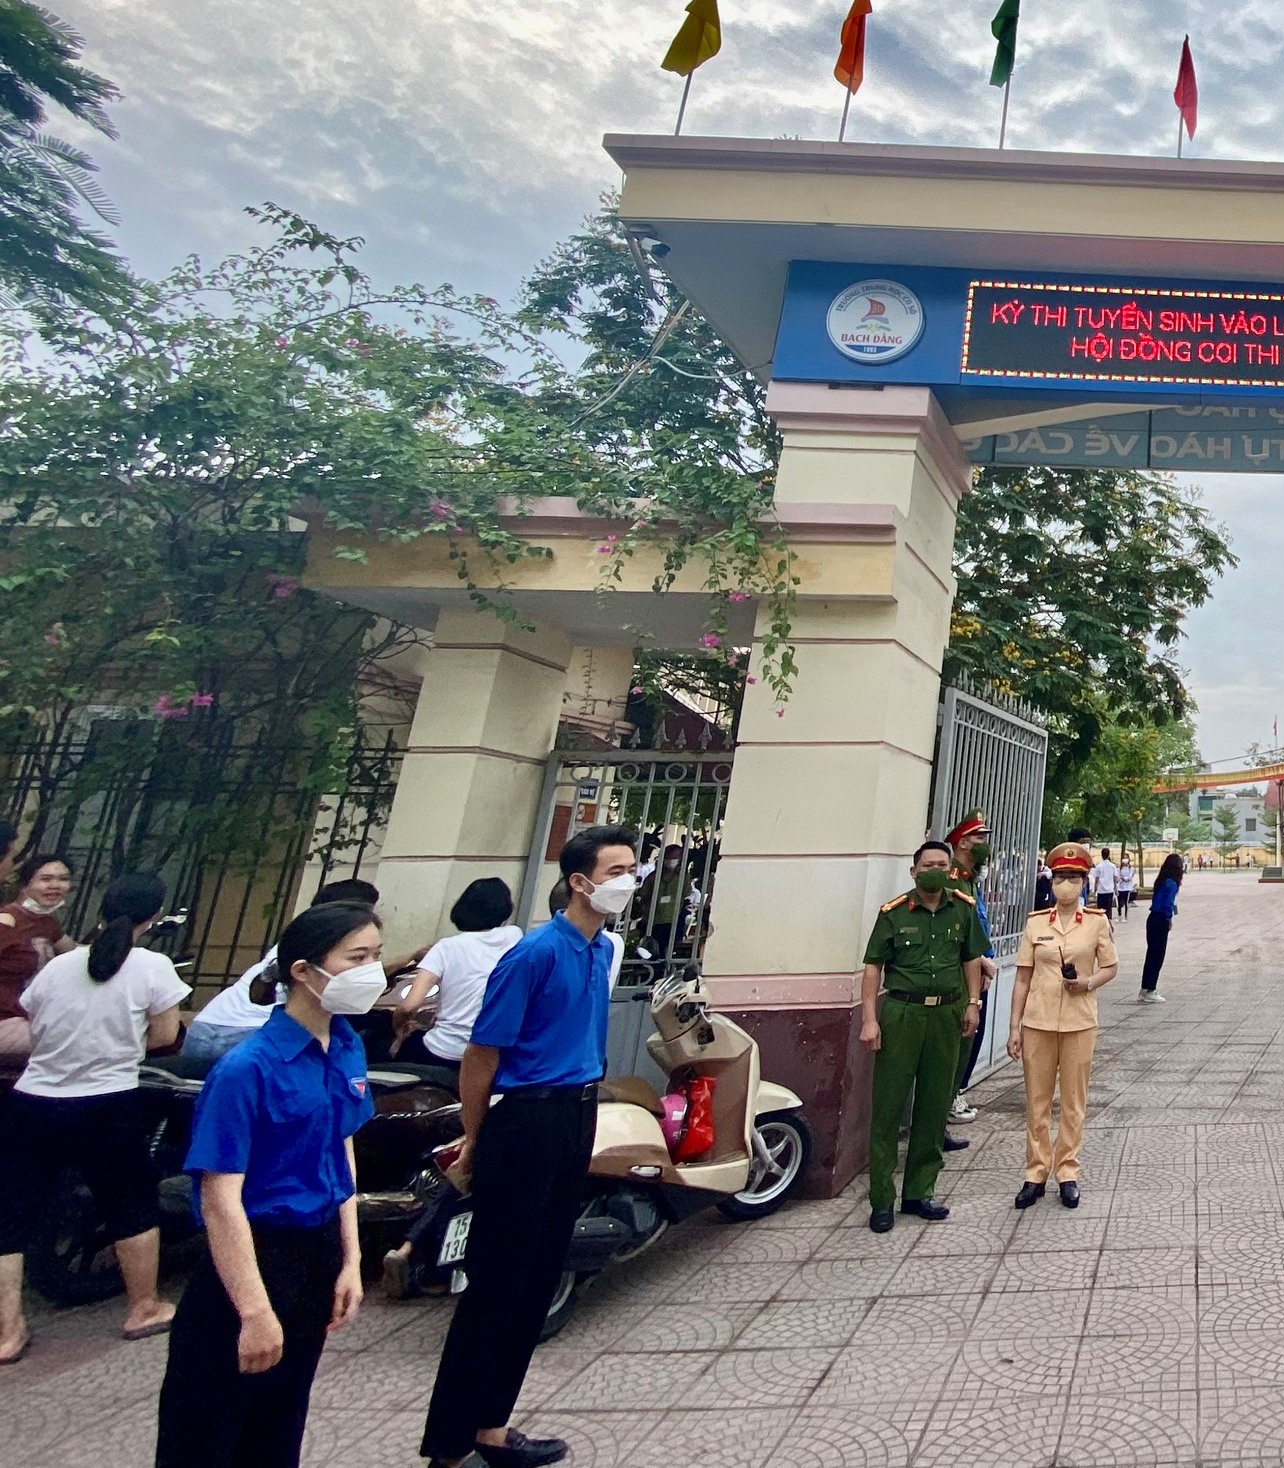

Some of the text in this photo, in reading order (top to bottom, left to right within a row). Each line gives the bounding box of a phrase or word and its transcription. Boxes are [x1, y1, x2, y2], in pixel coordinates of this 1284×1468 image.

[1031, 305, 1067, 327] THI
[1074, 301, 1153, 331] TUYỂN
[1159, 310, 1214, 333] SINH
[1219, 310, 1267, 335] VÀO
[1071, 332, 1113, 362] HỘI
[1120, 332, 1191, 362] ĐỒNG
[1198, 341, 1237, 364] COI
[1244, 343, 1280, 366] THI
